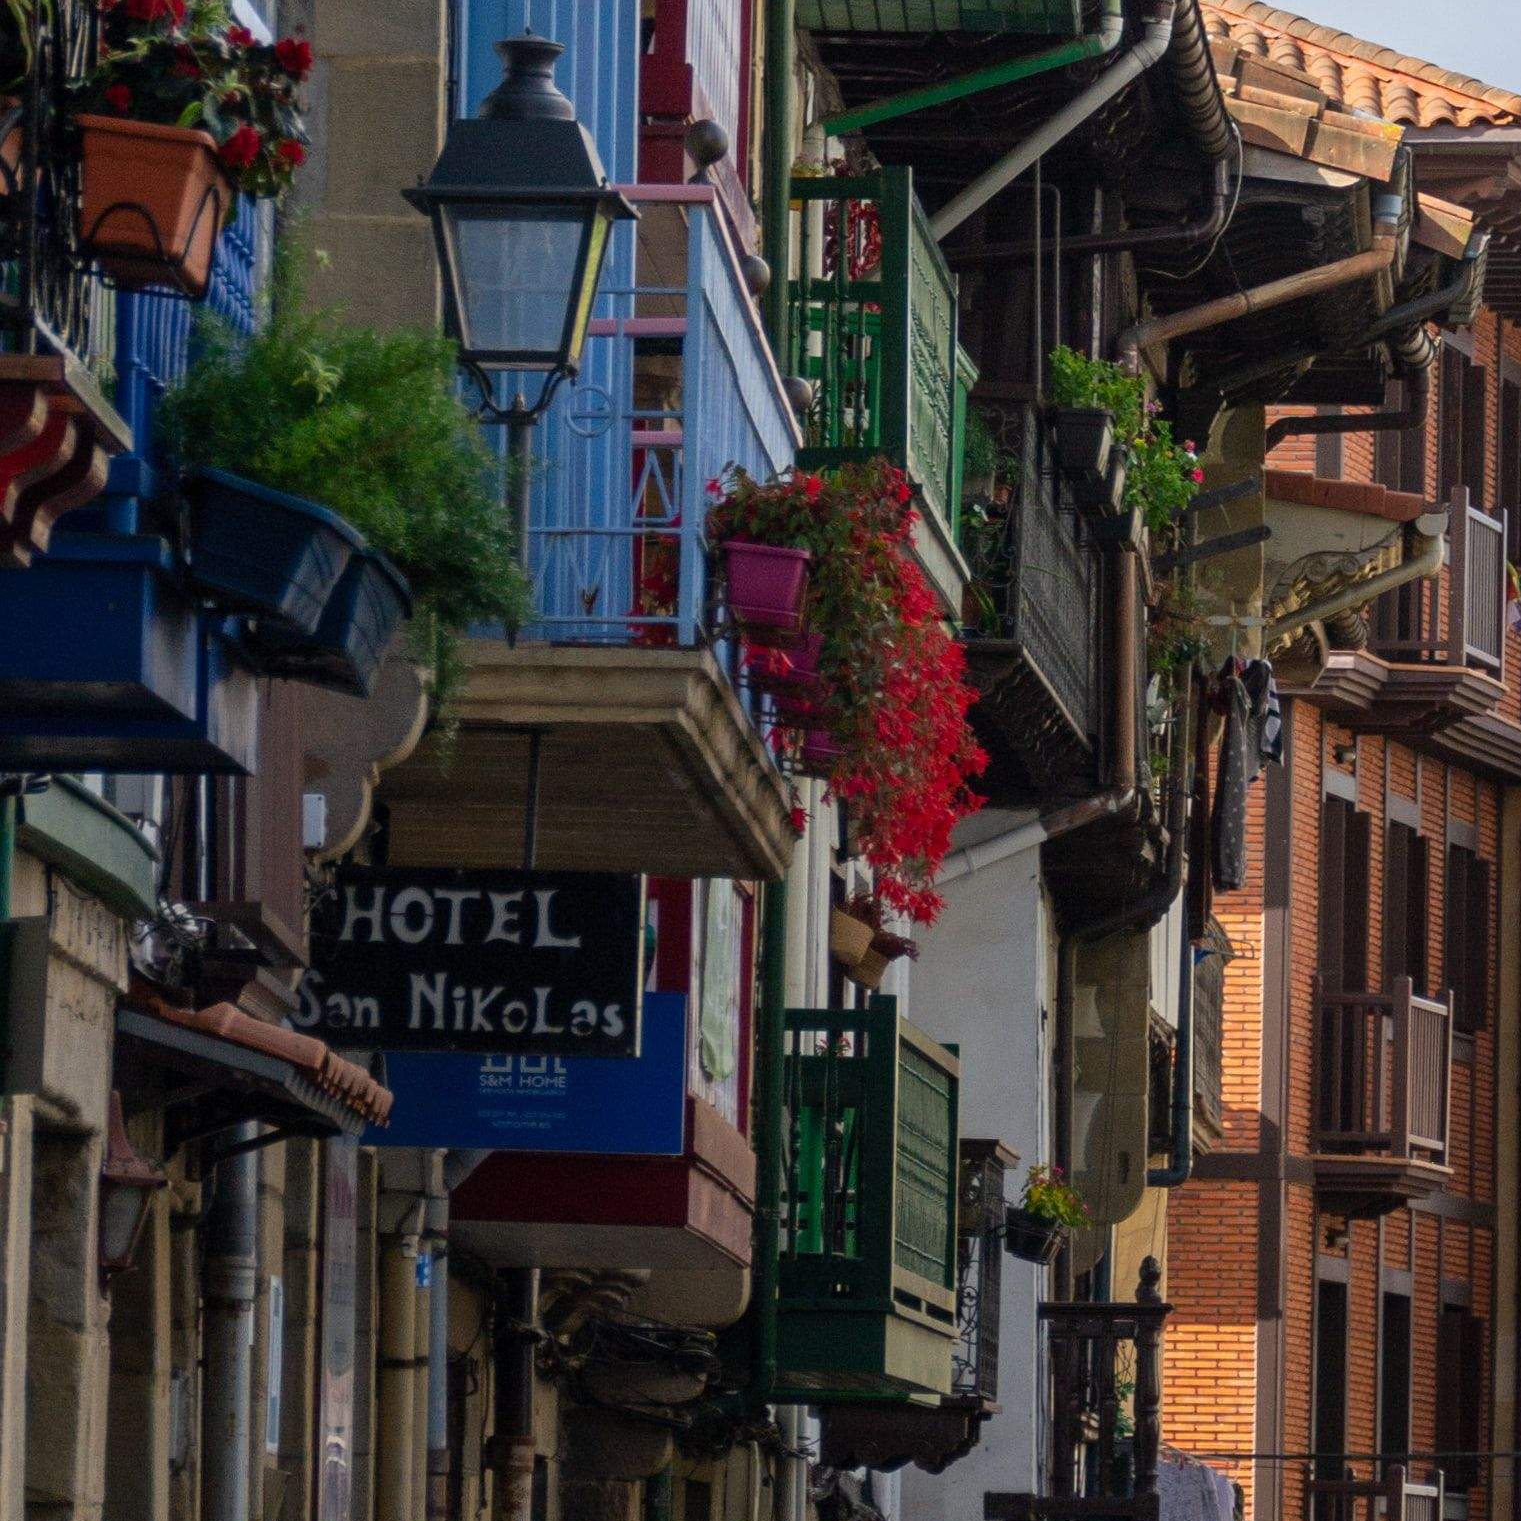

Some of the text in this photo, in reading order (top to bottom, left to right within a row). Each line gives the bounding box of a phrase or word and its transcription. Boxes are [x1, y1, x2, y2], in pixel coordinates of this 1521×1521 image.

[339, 886, 581, 948] HOTEL
[290, 968, 380, 1028] San
[479, 1074, 567, 1088] S&M HOME
